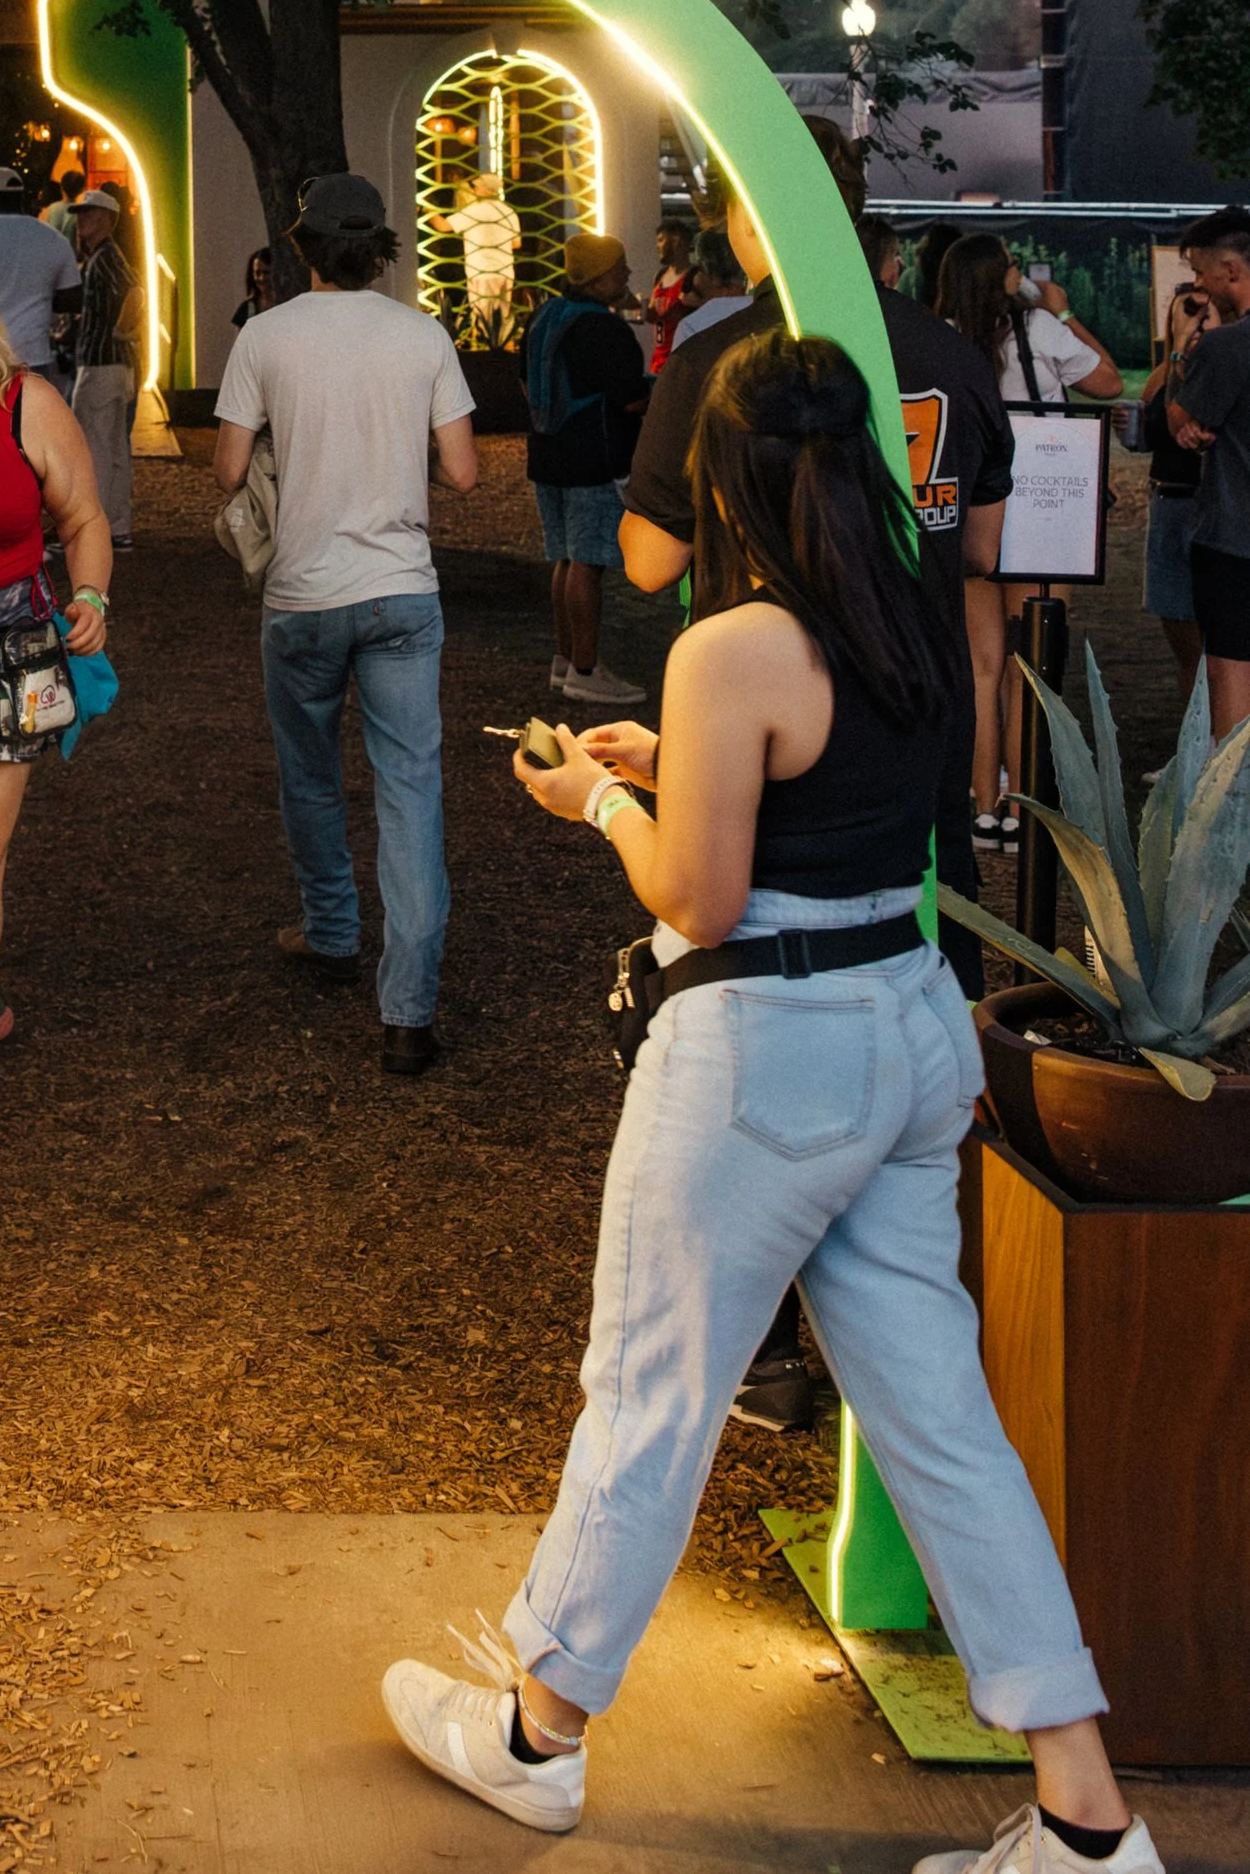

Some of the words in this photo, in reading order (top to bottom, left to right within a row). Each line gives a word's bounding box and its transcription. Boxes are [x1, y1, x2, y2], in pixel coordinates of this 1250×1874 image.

[1013, 475, 1029, 486] NO
[1030, 476, 1089, 487] COCKTAILS
[1014, 487, 1059, 498] BEYOND
[1061, 488, 1085, 499] THIS
[1032, 499, 1065, 510] POINT
